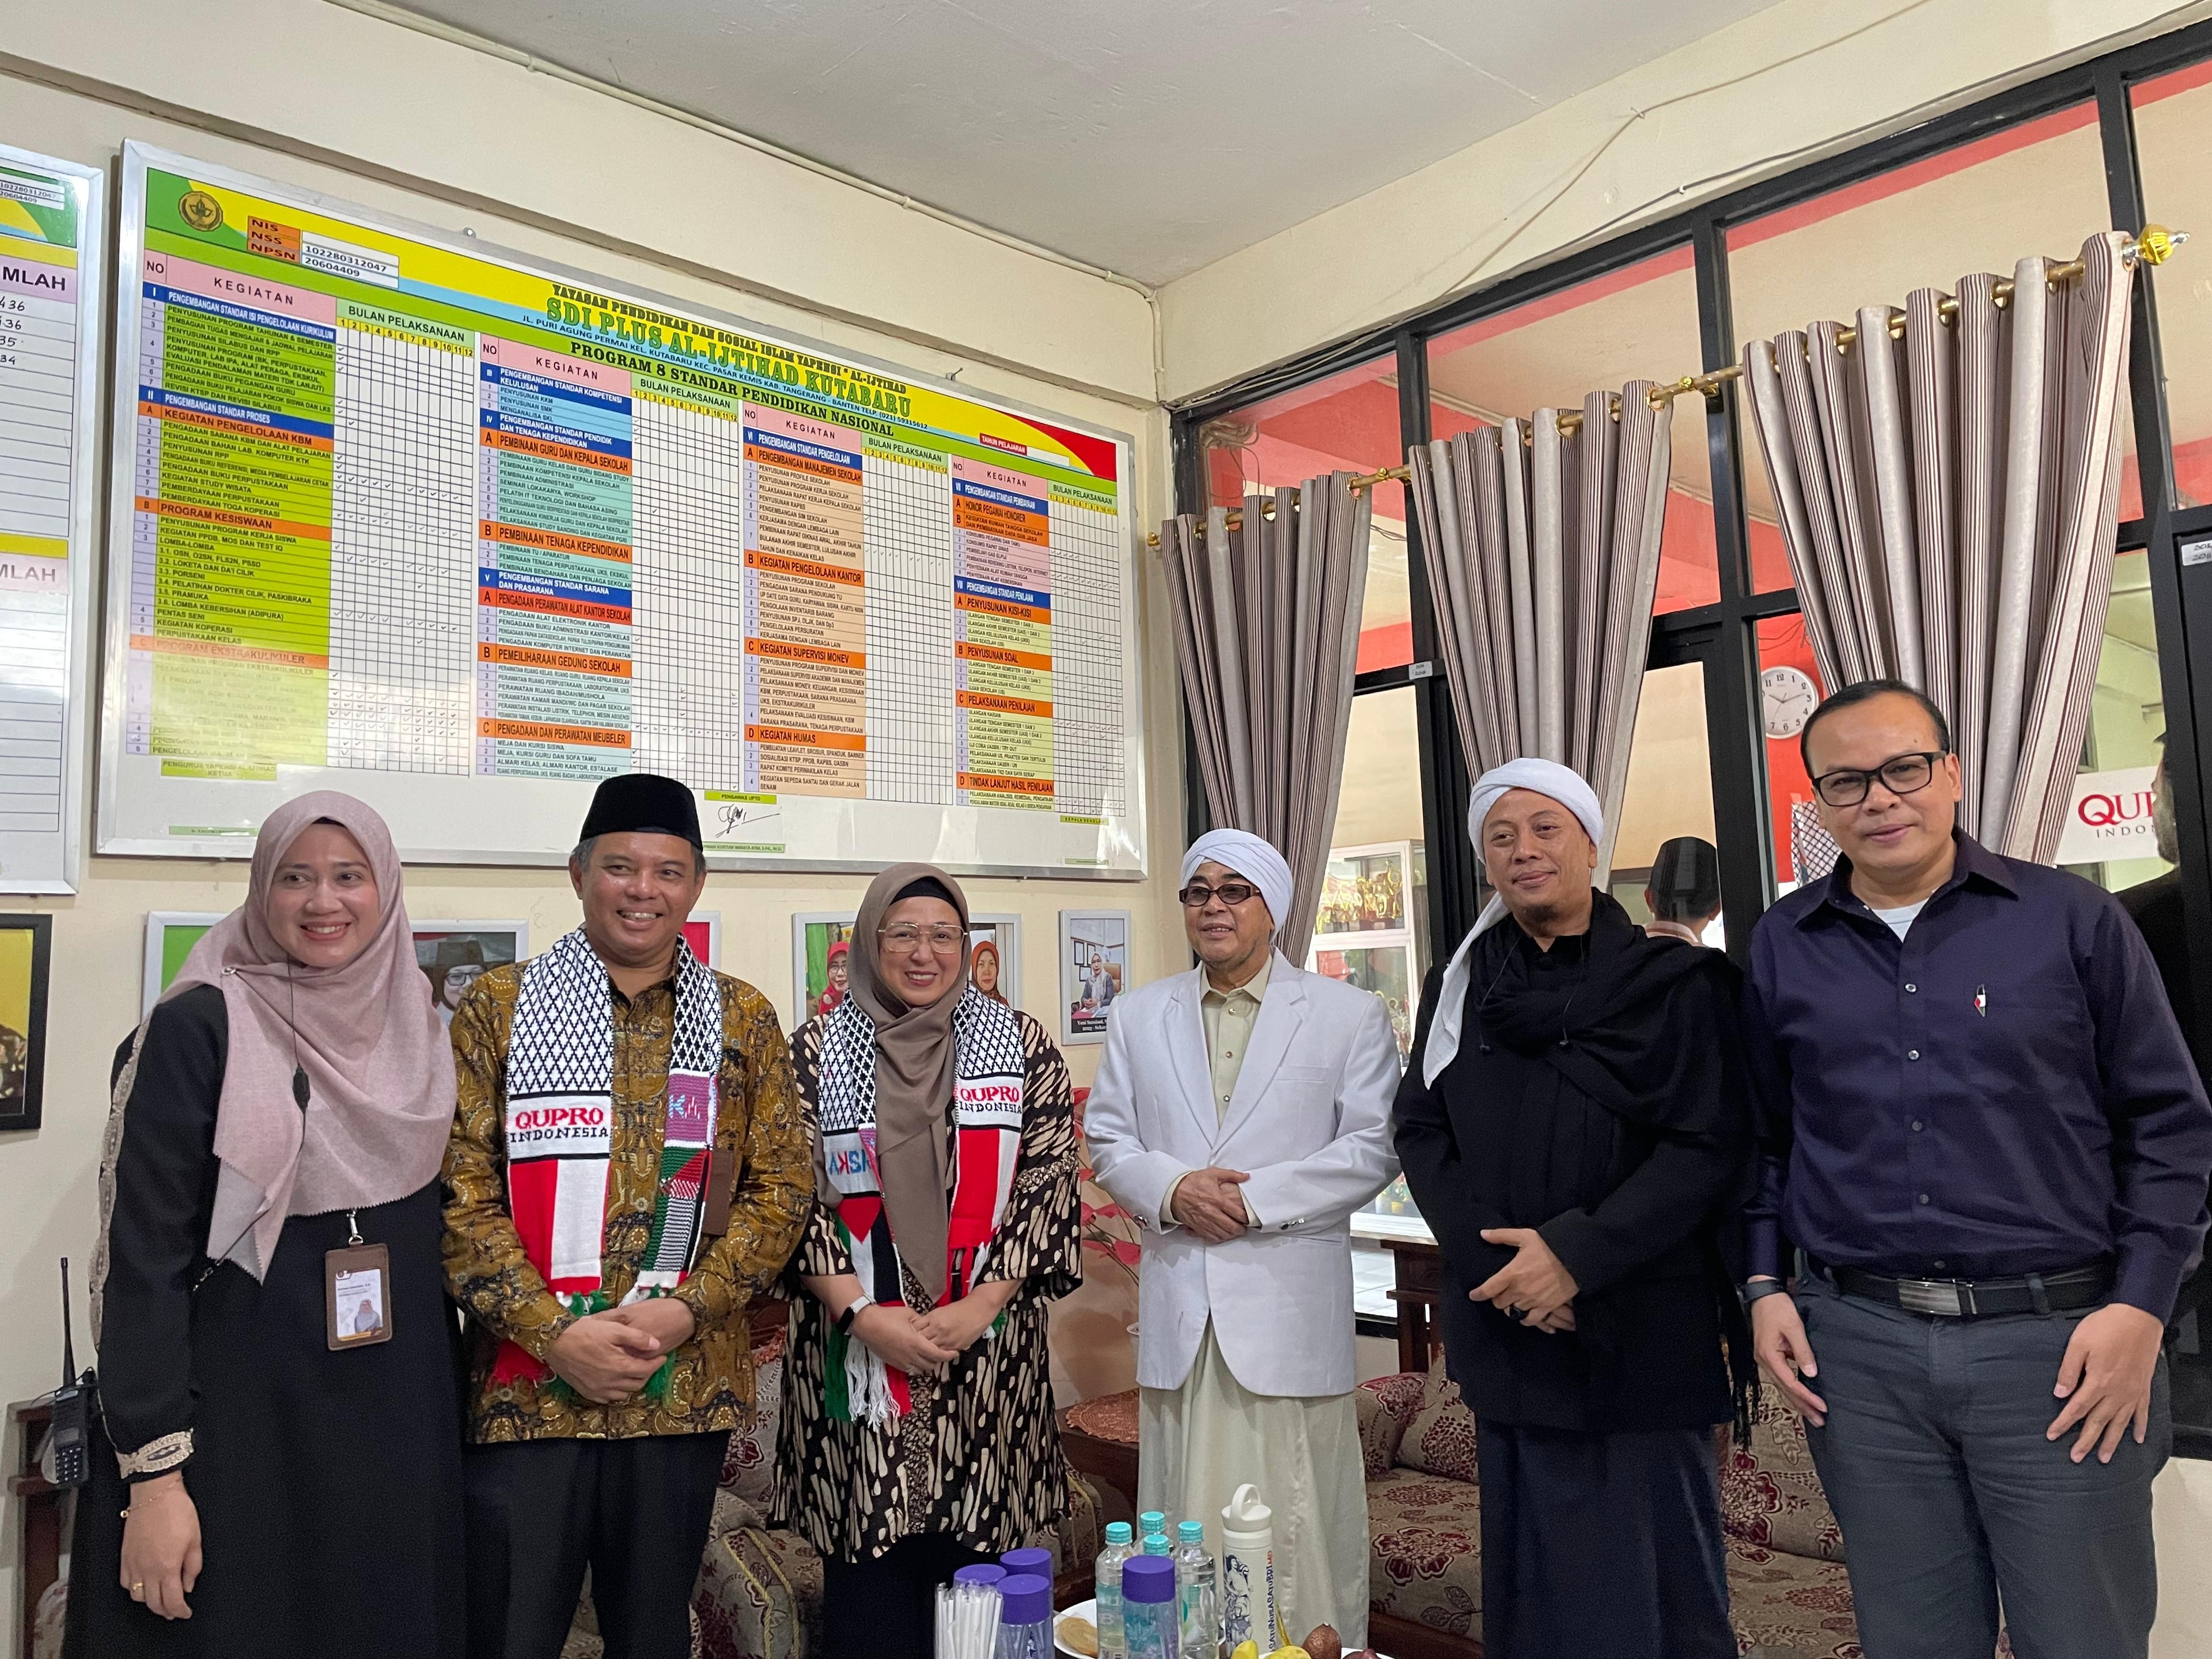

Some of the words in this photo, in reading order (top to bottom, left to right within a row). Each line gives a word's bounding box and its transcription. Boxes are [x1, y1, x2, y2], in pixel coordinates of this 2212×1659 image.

[251, 218, 278, 233] NIS
[251, 230, 282, 245] NSS
[305, 244, 387, 273] 102280312047
[251, 242, 296, 261] NPSN
[305, 256, 360, 278] 20604409
[146, 260, 164, 274] NO
[213, 276, 293, 306] KEGIATAN
[349, 305, 385, 323] BULAN
[388, 315, 464, 342] PELAKSANAAN
[168, 291, 219, 312] PENGEMBANGAN
[220, 304, 248, 319] STANDAR
[255, 313, 300, 332] PENGELOLAAN
[300, 324, 334, 340] KURIKULUM
[552, 283, 608, 310] YAYASAN
[611, 300, 688, 332] PENDIDIKAN
[694, 324, 714, 340] DAN
[718, 331, 756, 352] SOSIAL
[760, 344, 794, 363] ISLAM
[522, 315, 533, 324] JL.
[536, 318, 557, 330] PURI
[559, 324, 592, 340] AGUNG
[594, 334, 628, 349] PERMAI
[649, 349, 692, 366] KUTABARU
[713, 366, 737, 378] PASAR
[739, 373, 762, 385] KEMIS
[783, 385, 826, 403] TANGERANG
[832, 398, 859, 411] BANTEN
[879, 411, 896, 422] (021)
[546, 296, 592, 331] SDI
[599, 311, 662, 350] PLUS
[668, 331, 799, 388] AL-IJTIHAD
[805, 369, 911, 418] KUTABARU
[483, 343, 497, 355] NO
[536, 357, 598, 380] KEGIATAN
[640, 378, 668, 393] BULAN
[671, 386, 730, 408] PELAKSANAAN
[500, 377, 538, 392] KELULUSAN
[501, 368, 554, 387] PENGEMBANGAN
[555, 381, 583, 394] STANDAR
[584, 388, 622, 403] KOMPETENSI
[570, 341, 651, 373] PROGRAM
[657, 363, 665, 377] 8
[671, 368, 738, 396] STANDAR
[741, 387, 827, 419] PENDIDIKAN
[831, 410, 893, 437] NASIONAL
[164, 408, 214, 426] KEGIATAN
[217, 419, 289, 441] PENGELOLAAN
[291, 434, 312, 445] KBM
[500, 414, 553, 432] PENGEMBANGAN
[554, 426, 583, 438] STANDAR
[584, 432, 611, 445] PENDIDIK
[500, 423, 514, 432] DAN
[515, 426, 541, 438] TENAGA
[541, 432, 587, 448] KEPENDIDIKAN
[744, 409, 755, 419] NO
[786, 419, 835, 439] KEGIATAN
[868, 437, 891, 450] BULAN
[893, 443, 941, 462] PELAKSANAAN
[500, 434, 538, 452] PEMBINAAN
[539, 443, 558, 457] GURU
[559, 447, 573, 460] DAN
[574, 450, 598, 465] KEPALA
[599, 456, 627, 472] SEKOLAH
[759, 449, 804, 469] PENGEMBANGAN
[804, 460, 836, 476] MANAJEMEN
[837, 468, 861, 482] SEKOLAH
[953, 462, 963, 471] NO
[987, 471, 1027, 487] KEGIATAN
[1053, 484, 1071, 495] BULAN
[1073, 489, 1112, 505] PELAKSANAAN
[161, 503, 211, 520] PROGRAM
[214, 512, 272, 529] KESISWAAN
[499, 527, 543, 544] PEMBINAAN
[546, 535, 575, 550] TENAGA
[577, 540, 628, 559] KEPENDIDIKAN
[499, 571, 553, 586] PENGEMBANGAN
[554, 579, 583, 591] STANDAR
[584, 584, 609, 594] SARANA
[759, 555, 790, 570] KEGIATAN
[791, 562, 836, 578] PENGELOLAAN
[837, 570, 861, 583] KANTOR
[498, 581, 513, 589] DAN
[514, 583, 554, 596] PRASARANA
[967, 598, 1007, 613] PENYUSUNAN
[1008, 605, 1031, 618] KISI-KISI
[558, 656, 587, 669] GEDUNG
[589, 660, 620, 673] SEKOLAH
[760, 642, 791, 656] KEGIATAN
[793, 647, 825, 660] SUPERVISI
[827, 652, 849, 664] MONEV
[968, 646, 1003, 660] PENYUSUNAN
[1004, 652, 1018, 662] SOAL
[968, 695, 1007, 709] PELAKSANAAN
[1008, 700, 1035, 712] PENILAIAN
[760, 729, 791, 741] KEGIATAN
[793, 732, 816, 743] HUMAS
[969, 777, 989, 787] TINDAK
[990, 779, 1010, 789] LANJUT
[1011, 781, 1026, 790] HASIL
[1027, 782, 1053, 792] PENILAIAN
[959, 1101, 1022, 1115] INDONESIA
[960, 1085, 1020, 1103] QUPRO
[515, 1107, 604, 1130] QUPRO
[510, 1126, 609, 1143] INDONESIA
